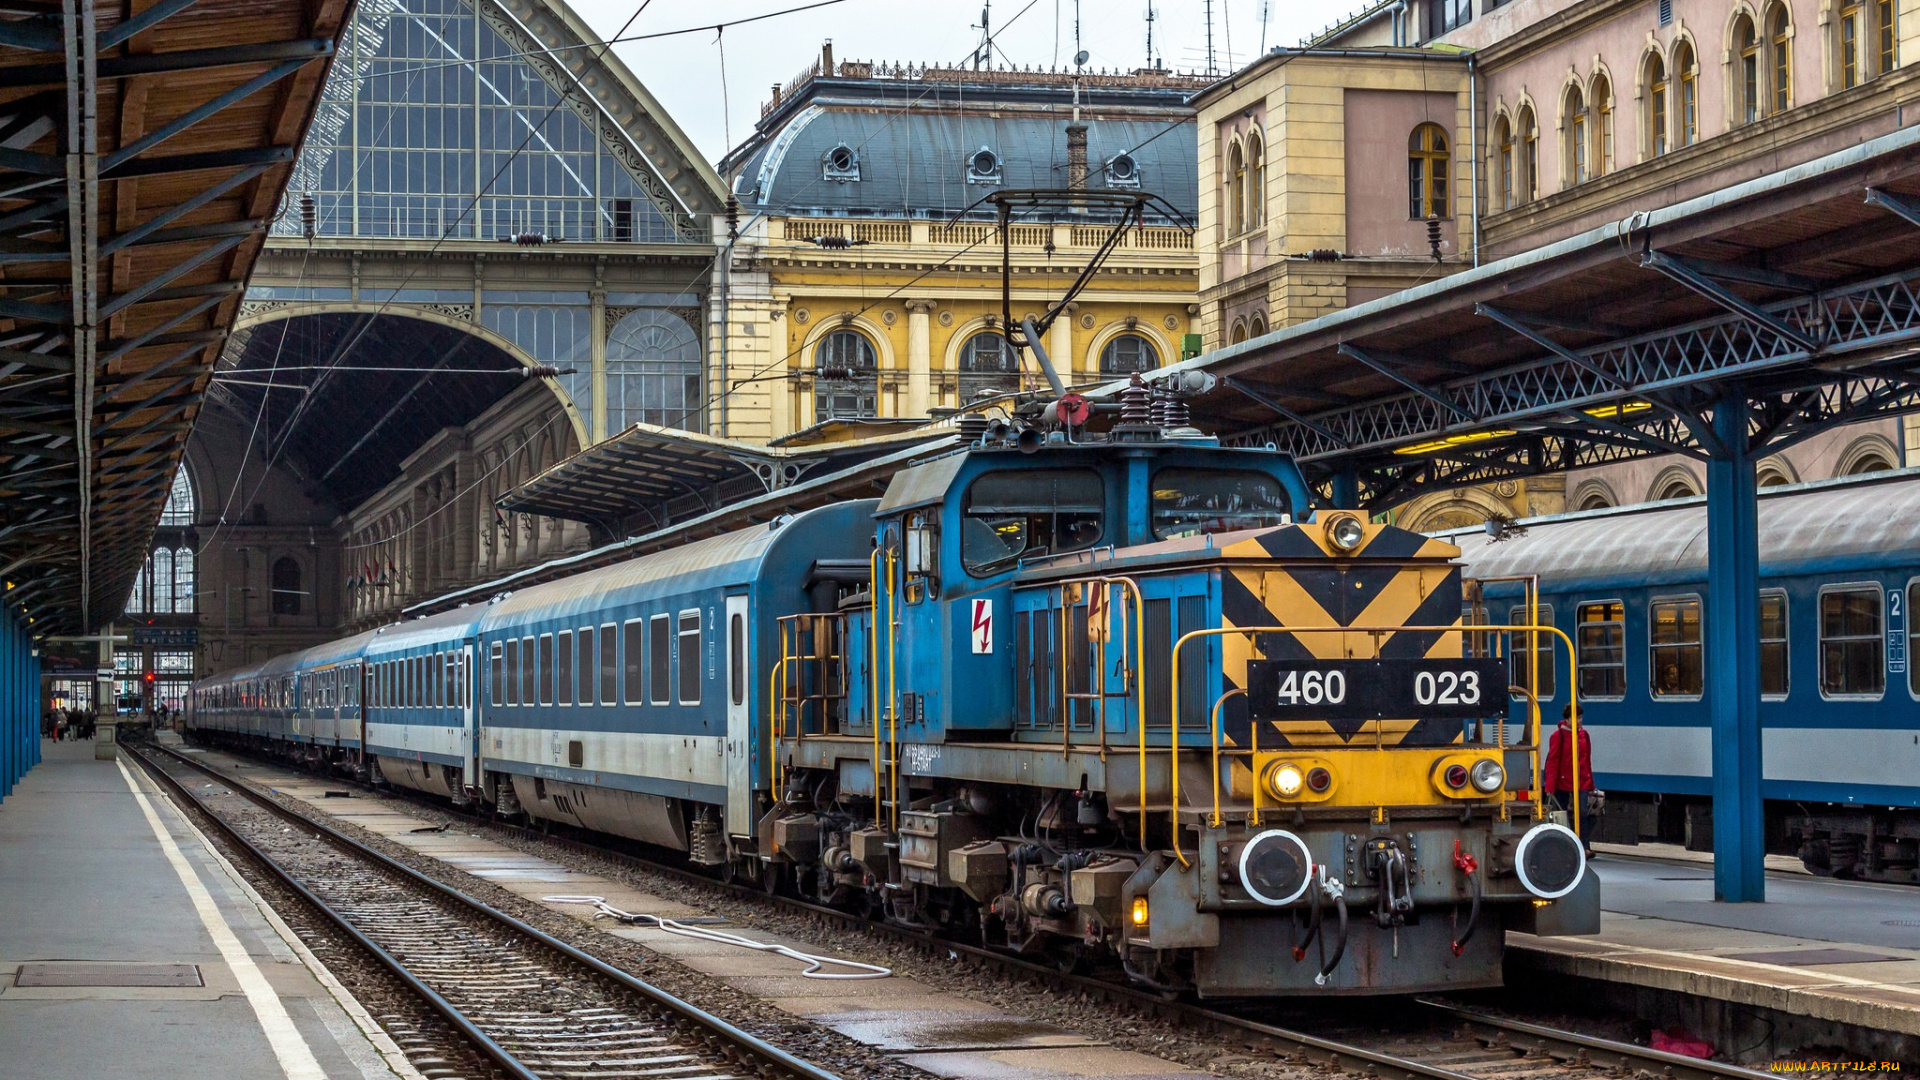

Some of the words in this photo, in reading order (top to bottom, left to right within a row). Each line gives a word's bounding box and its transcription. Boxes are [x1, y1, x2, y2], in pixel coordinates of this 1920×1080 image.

[1891, 592, 1901, 616] 2
[1278, 670, 1346, 705] 460
[1414, 671, 1481, 705] 023
[911, 756, 932, 772] H-START
